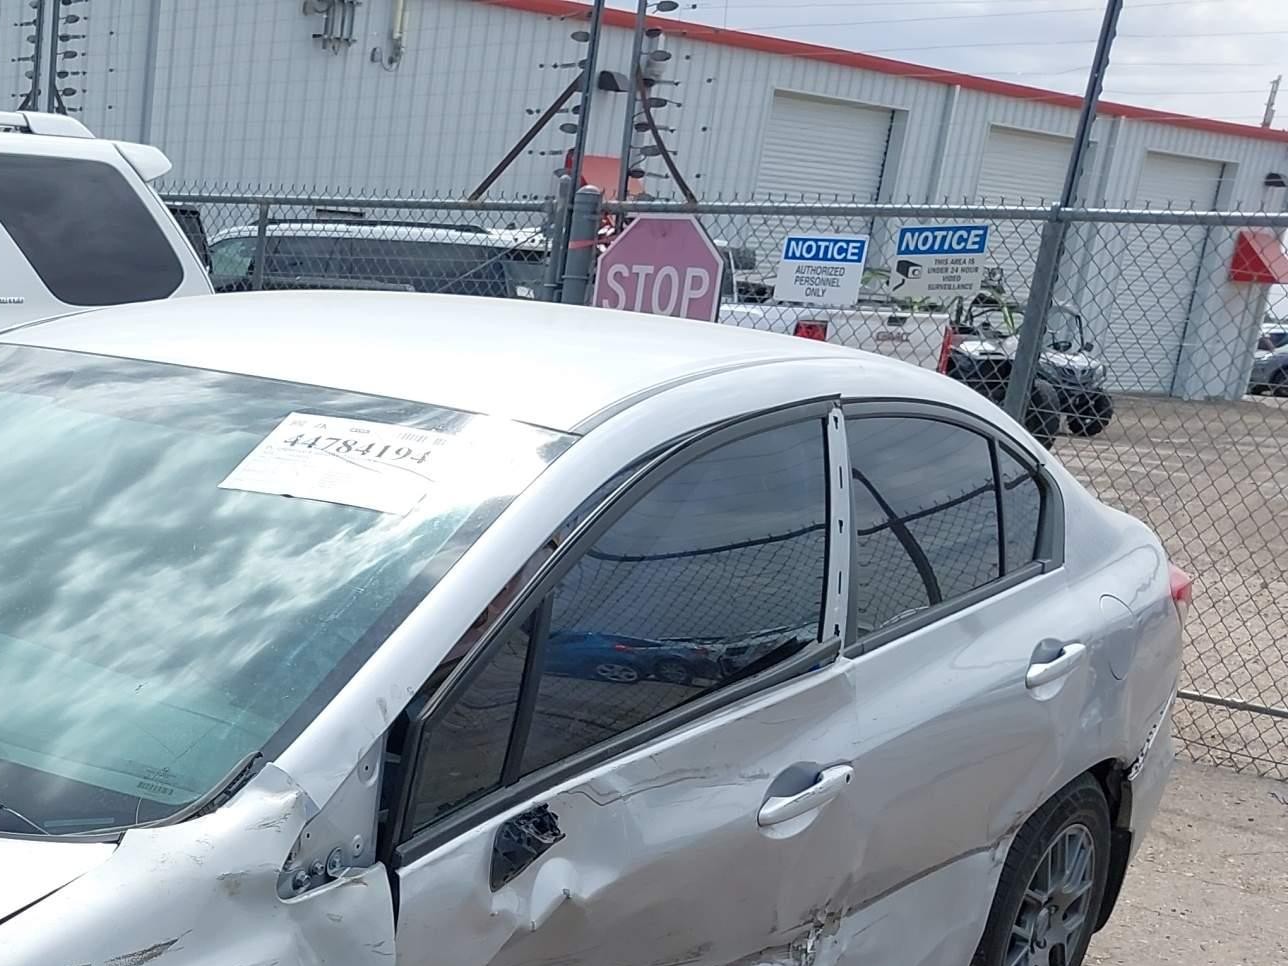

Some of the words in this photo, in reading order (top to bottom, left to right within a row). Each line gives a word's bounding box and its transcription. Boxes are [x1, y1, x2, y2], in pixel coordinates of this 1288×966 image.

[787, 240, 861, 260] NOTICE
[901, 230, 984, 251] NOTICE
[795, 265, 845, 277] AUTHORIZED
[602, 264, 710, 318] STOP
[794, 275, 841, 288] PERSONNEL
[805, 287, 827, 298] ONLY
[283, 433, 432, 464] 44784194
